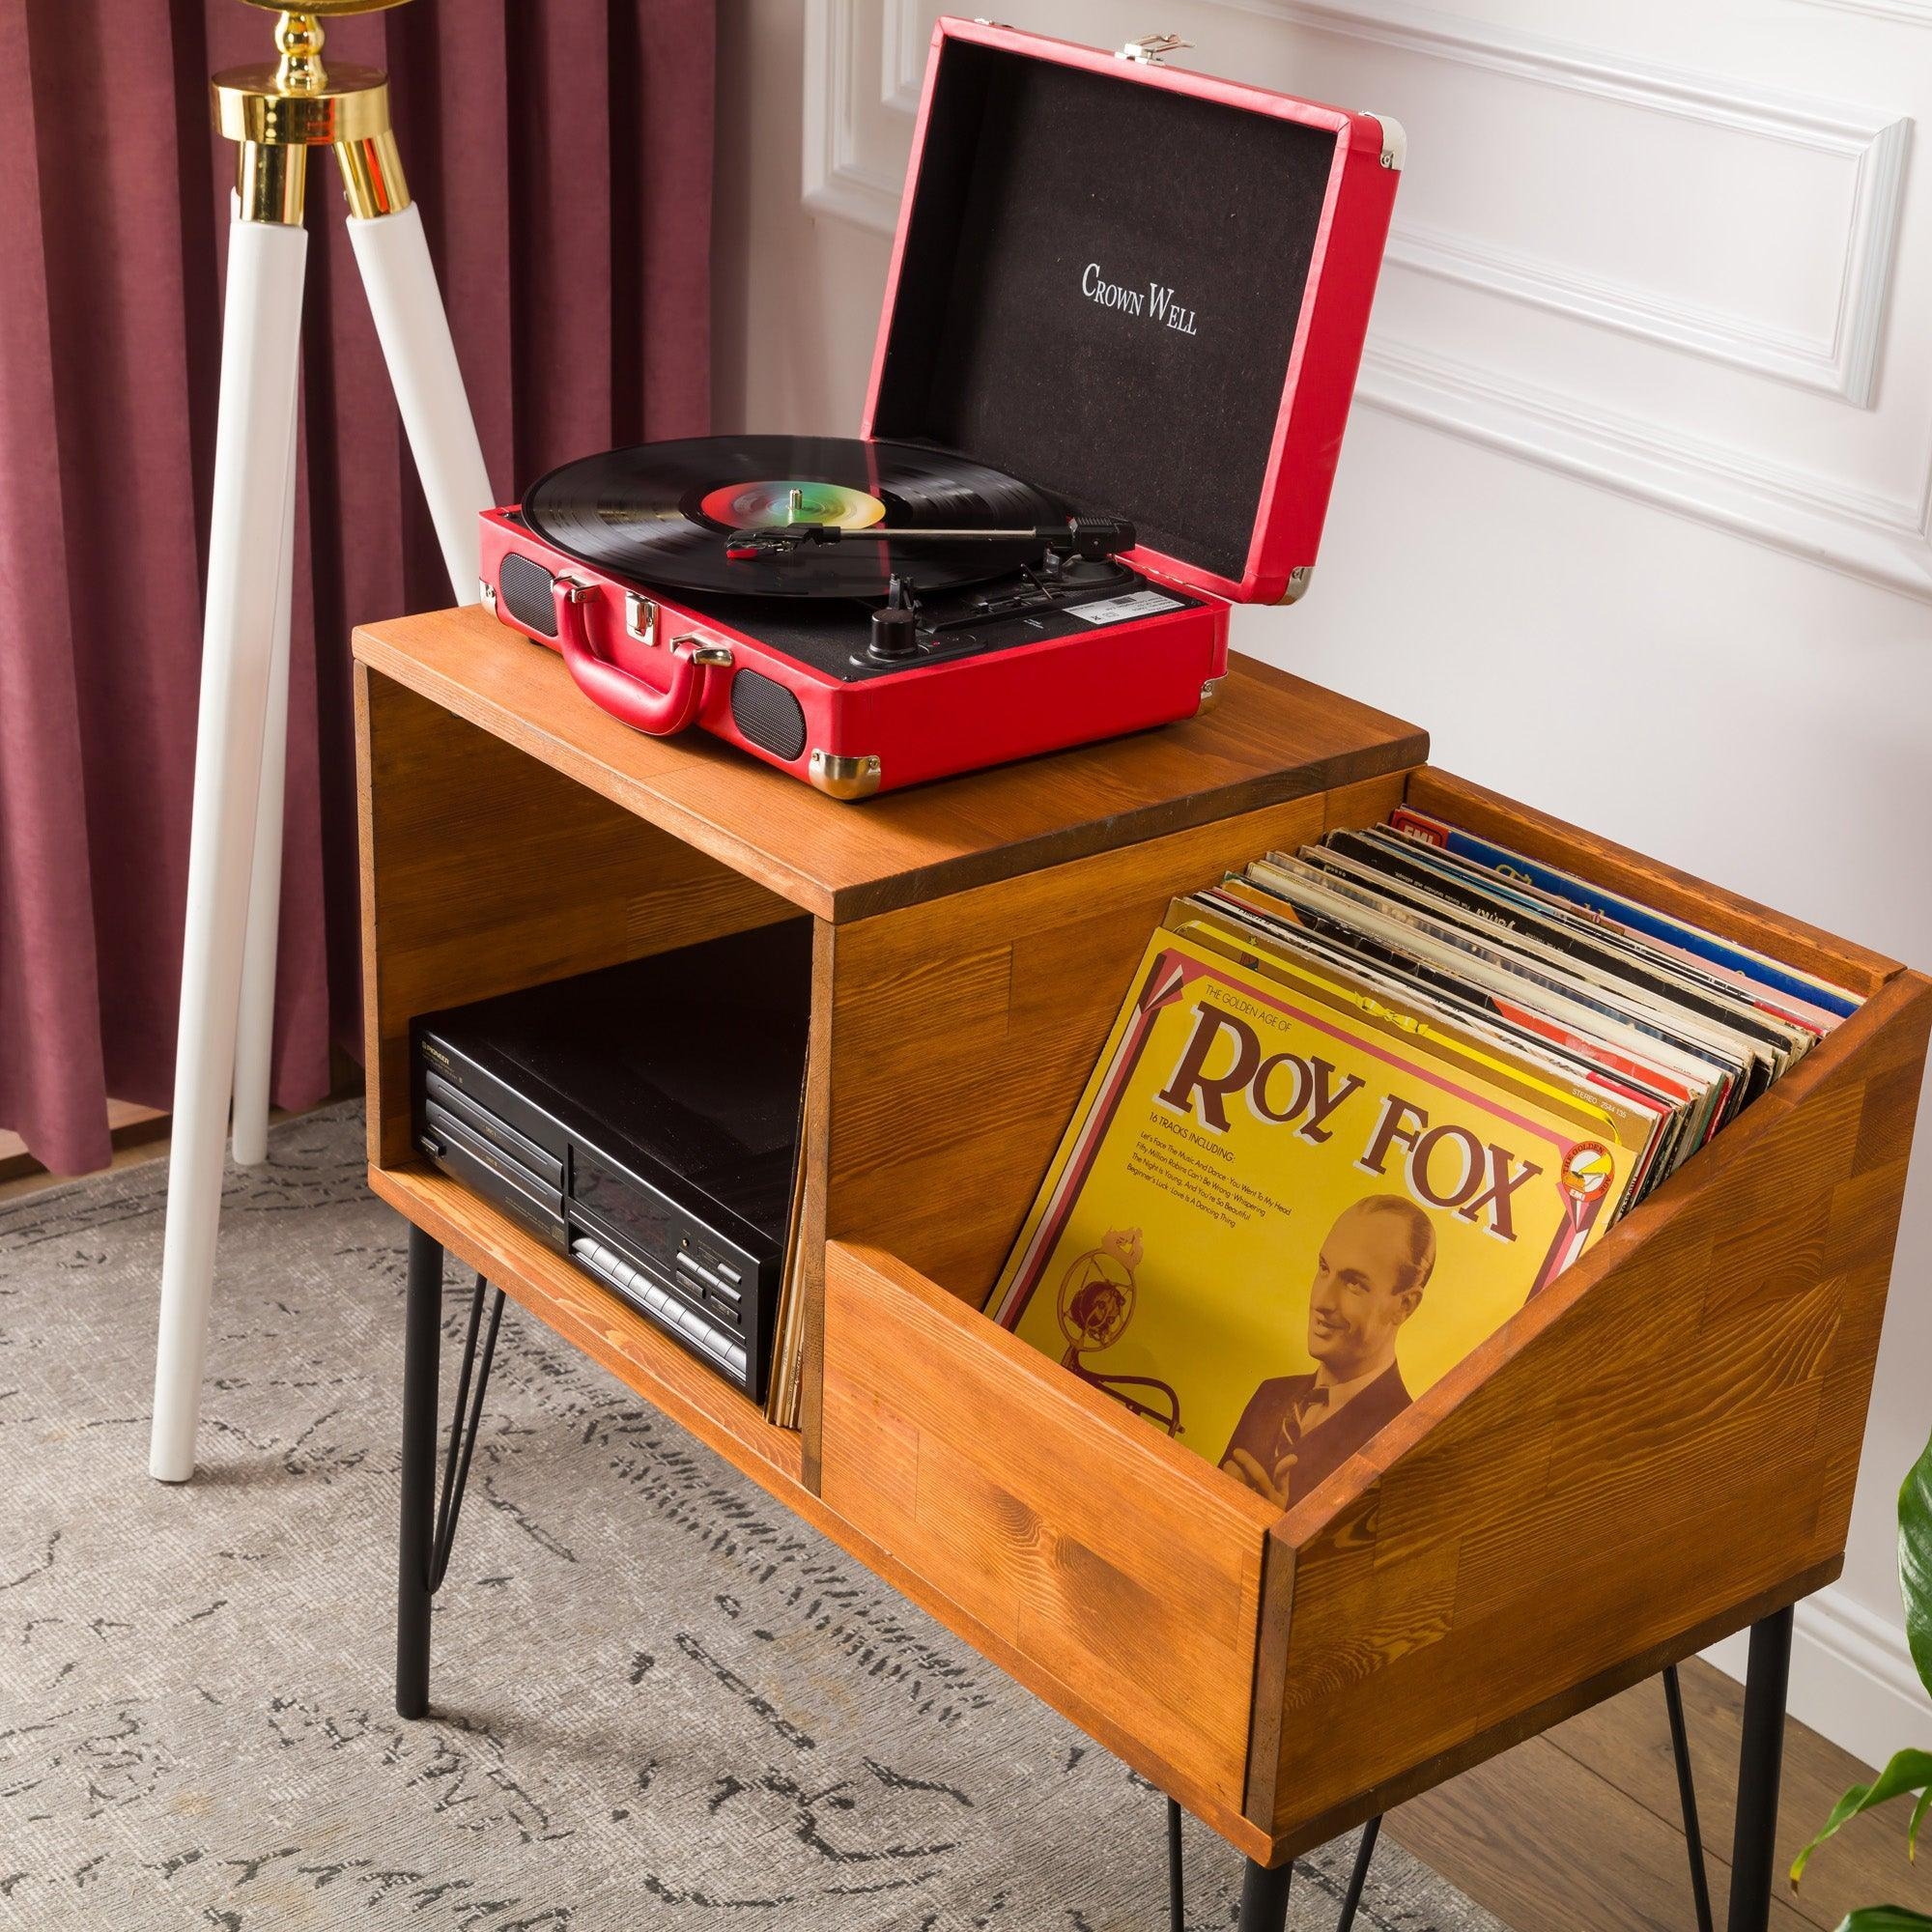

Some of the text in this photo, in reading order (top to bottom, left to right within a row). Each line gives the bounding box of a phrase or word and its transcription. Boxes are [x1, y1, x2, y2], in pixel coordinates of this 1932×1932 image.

[1082, 263, 1197, 335] CROWN WELL
[1205, 984, 1292, 1033] THE GOLDEN AGE OF
[1154, 1001, 1543, 1242] ROY FOX
[1572, 1089, 1597, 1104] STEREO
[1149, 1111, 1236, 1164] 16 TRACKS INCLUDING:
[1126, 1163, 1157, 1184] Beginner's
[1155, 1179, 1169, 1191] Luck
[1171, 1186, 1184, 1199] Love
[1189, 1197, 1197, 1206] A
[1195, 1200, 1221, 1218] Dancing
[1219, 1212, 1236, 1227] Thing
[1131, 1152, 1143, 1163] The
[1142, 1158, 1158, 1172] Night
[1184, 1180, 1197, 1192] And
[1197, 1187, 1216, 1203] You're
[1215, 1198, 1225, 1208] So
[1136, 1142, 1266, 1216] Fifty Million Robins Can't Be Wrong Whispering
[1141, 1131, 1292, 1215] Let's Face The Music And Dance You Went To My Head
